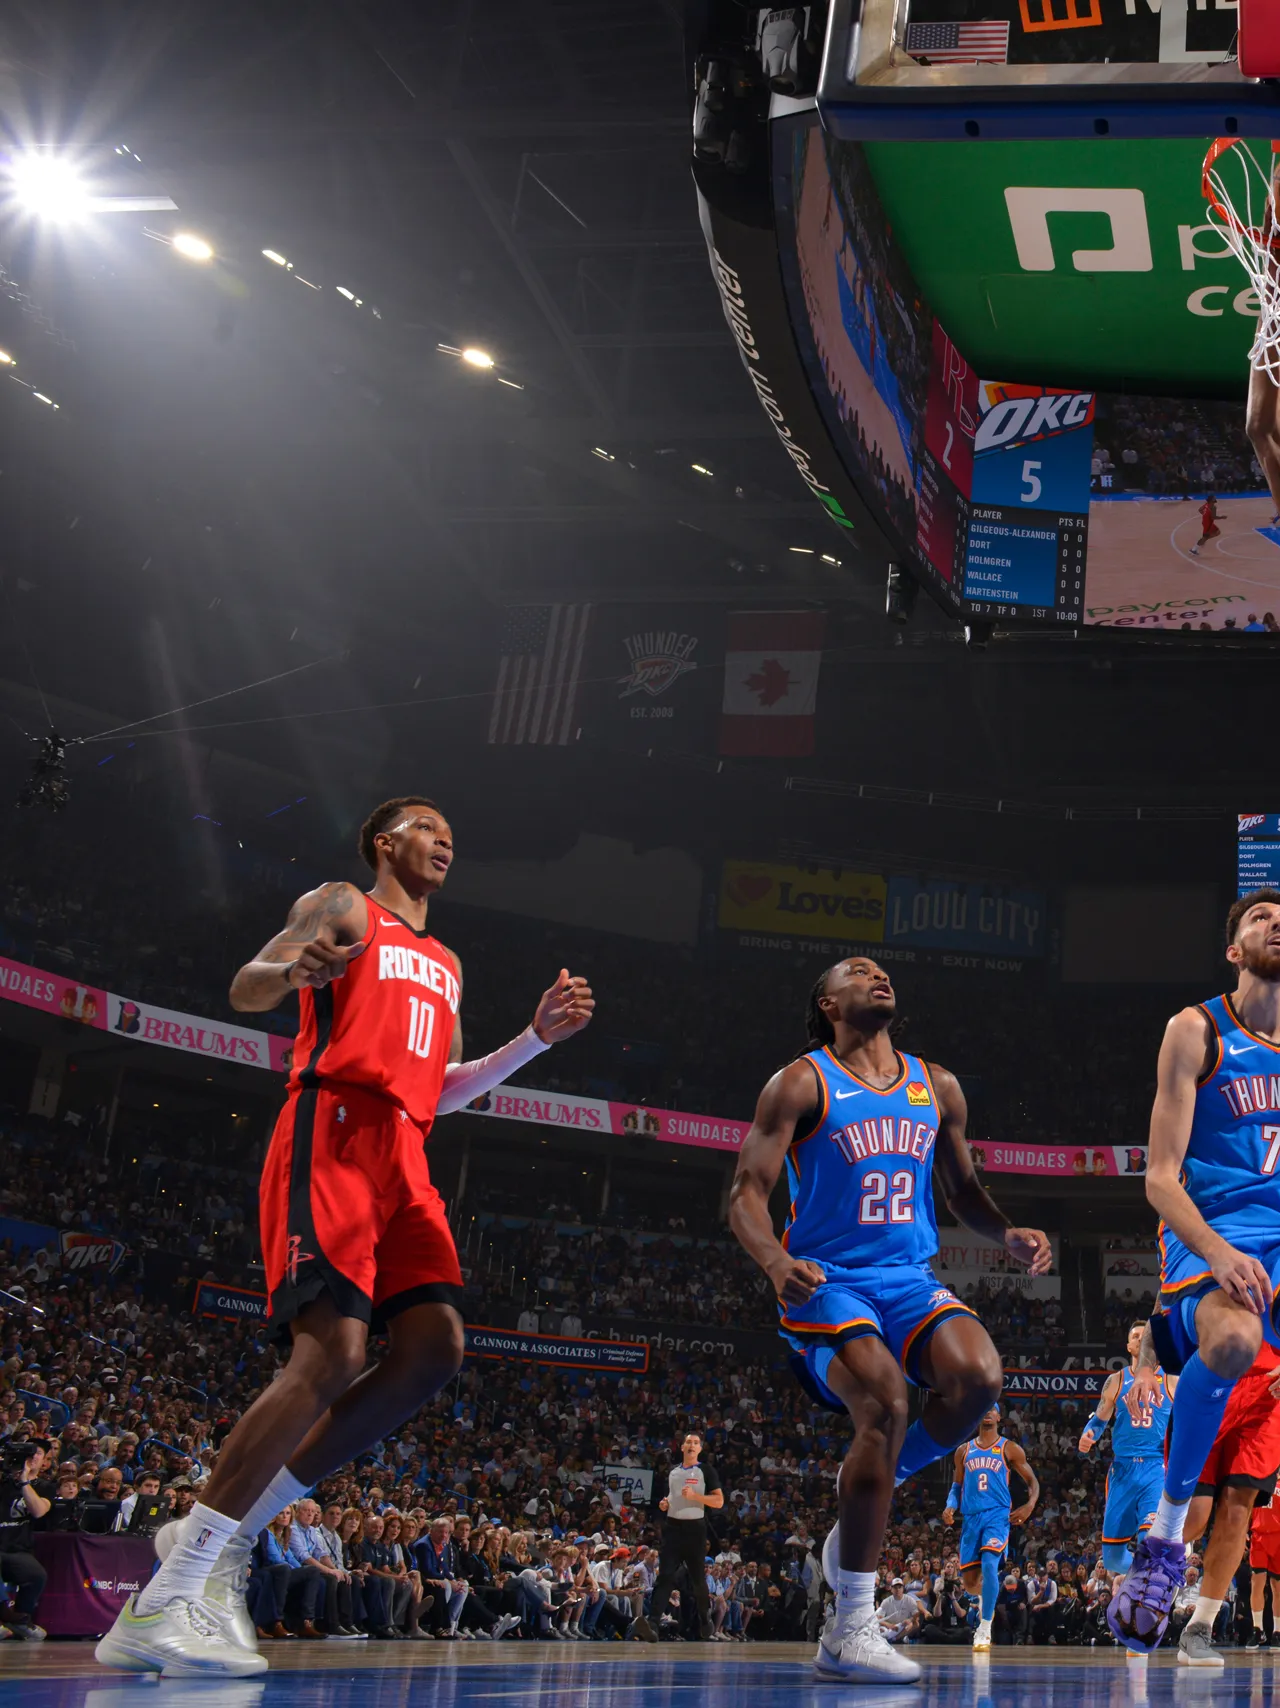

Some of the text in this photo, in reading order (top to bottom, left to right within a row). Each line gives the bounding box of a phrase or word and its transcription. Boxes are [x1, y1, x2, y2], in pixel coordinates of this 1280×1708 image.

[974, 394, 1092, 452] OKC
[1020, 460, 1042, 503] 5
[973, 509, 1085, 528] PLAYER PTS FL
[970, 524, 1056, 541] GILGEOUS-ALEXANDER
[969, 539, 991, 550] DORT
[968, 555, 1011, 567] HOLMGREN
[1061, 564, 1067, 572] 5
[967, 571, 1002, 582] WALLACE
[966, 586, 1018, 600] HARTENSTEIN
[970, 603, 1078, 621] TO 7 TF 0 1ST 10:09
[1087, 595, 1247, 618] paycom
[1094, 609, 1214, 626] center
[622, 630, 698, 660] THUNDER
[650, 707, 674, 718] 2008
[1238, 815, 1265, 832] OKC
[891, 890, 966, 936] LOUD
[978, 896, 1040, 947] CITY
[738, 936, 1023, 972] BRING THE THUNDER EXIT NOW
[379, 945, 460, 1014] ROCKETS
[407, 995, 435, 1059] 10
[143, 1017, 260, 1062] BRAUM'S
[495, 1095, 601, 1129] BRAUM'S
[667, 1117, 741, 1144] SUNDAES
[829, 1115, 937, 1166] THUNDER
[993, 1149, 1066, 1168] SUNDAES
[858, 1170, 914, 1224] 22
[1015, 1278, 1033, 1290] OAK
[217, 1296, 262, 1315] CANNON
[473, 1335, 596, 1359] CANNON & ASSOCIATES
[602, 1347, 645, 1358] Criminal Defense
[608, 1354, 636, 1363] Family Law
[1001, 1375, 1098, 1391] CANNON &
[966, 1456, 1002, 1472] THUNDER
[978, 1473, 988, 1491] 2
[99, 1580, 140, 1594] NBC peacock
